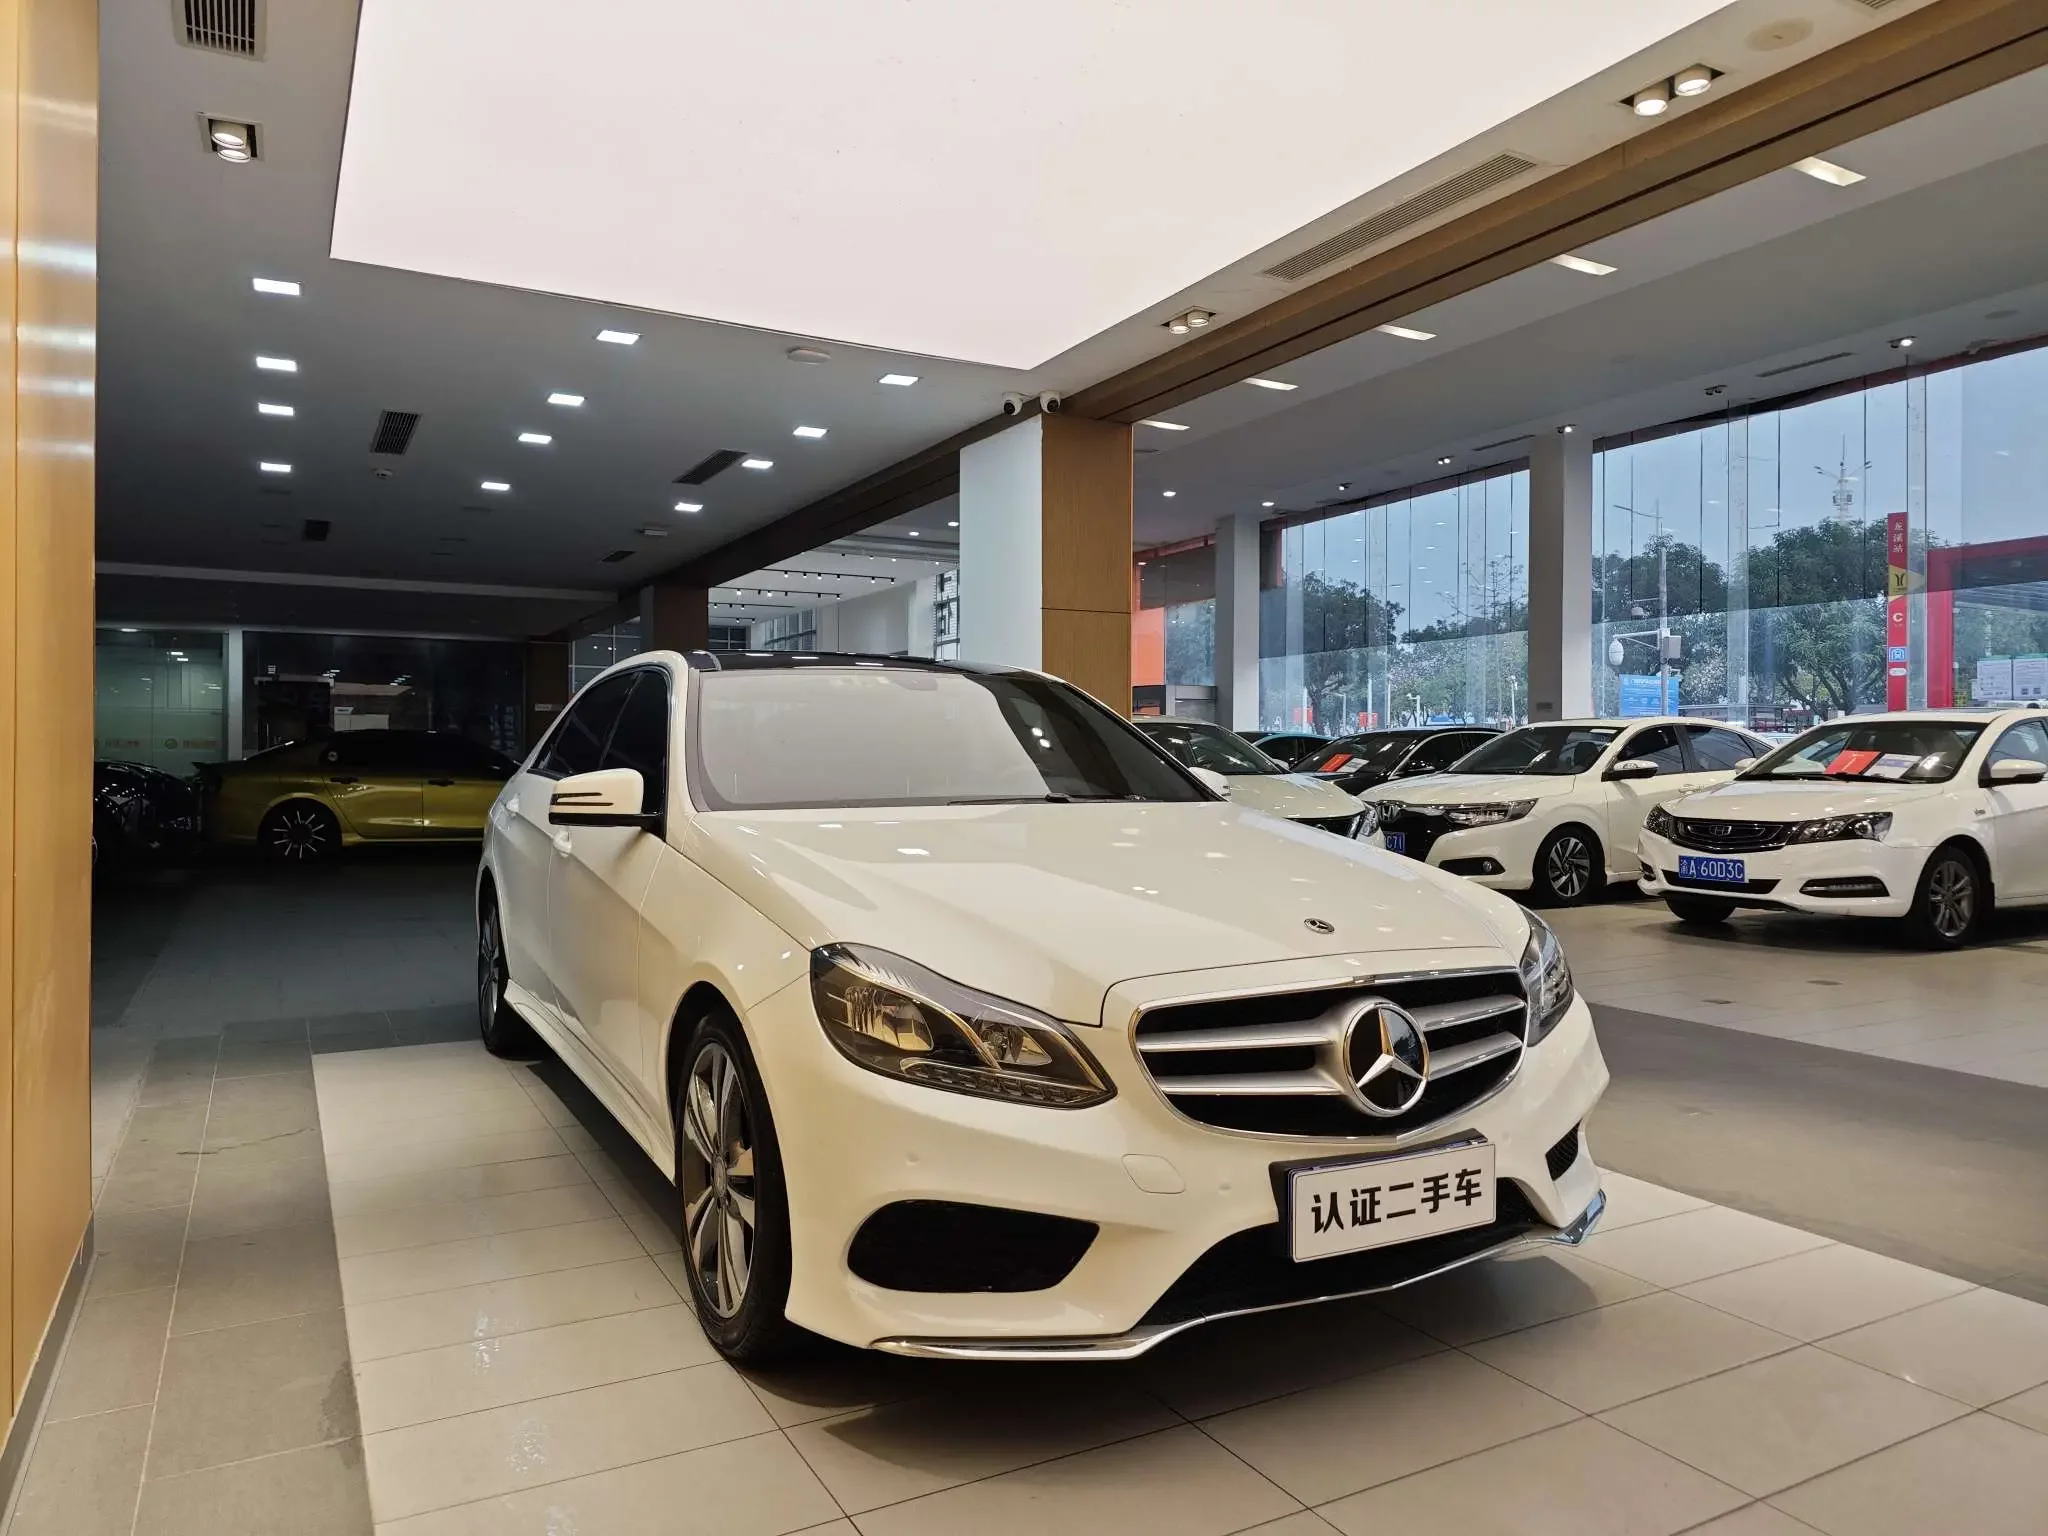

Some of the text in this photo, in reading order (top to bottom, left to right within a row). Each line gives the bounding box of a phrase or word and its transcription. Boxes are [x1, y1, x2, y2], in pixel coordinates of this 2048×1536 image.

[1311, 1168, 1482, 1233] 认证二手车
